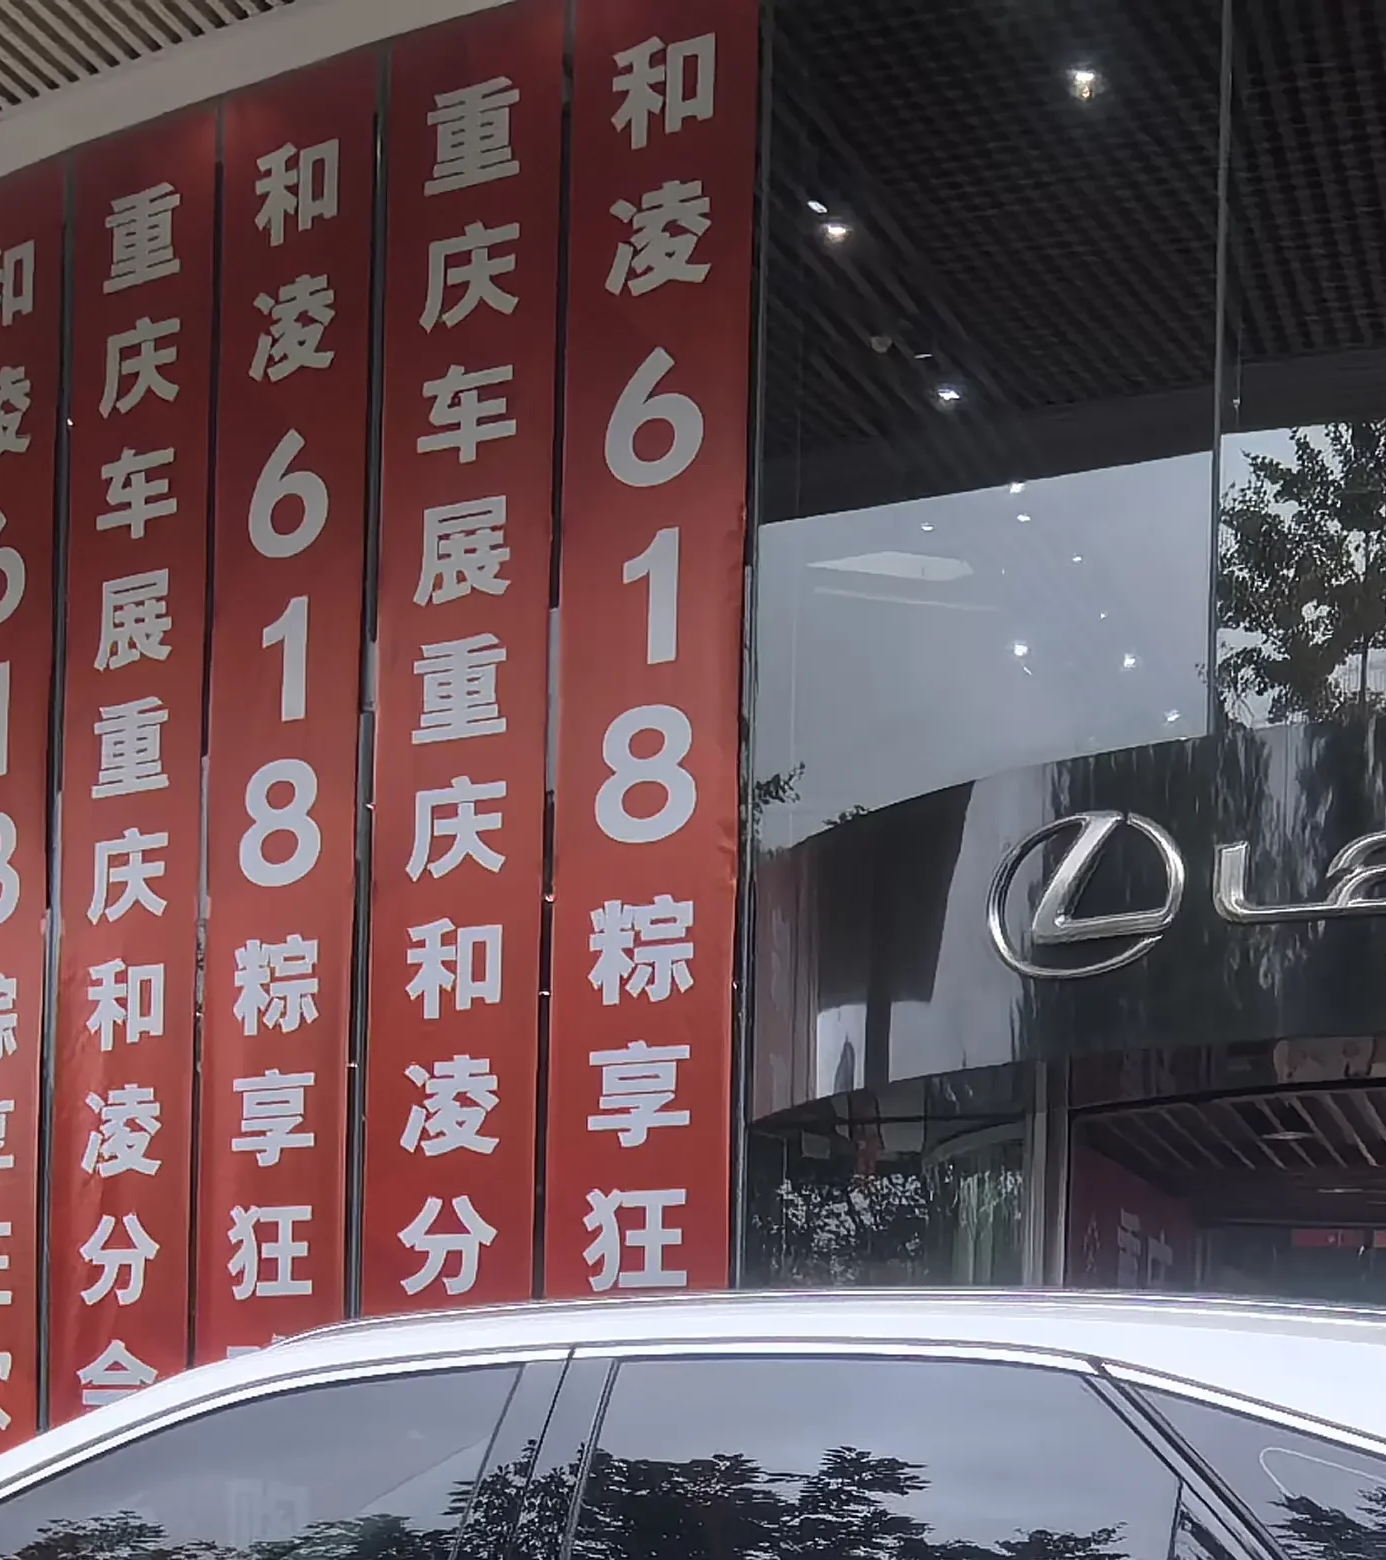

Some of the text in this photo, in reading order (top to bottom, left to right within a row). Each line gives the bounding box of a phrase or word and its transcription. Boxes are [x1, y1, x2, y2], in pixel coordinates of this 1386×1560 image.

[226, 139, 340, 1356] 和凌618粽享狂
[398, 75, 522, 1296] 重庆车展重庆和凌分
[582, 32, 716, 1292] 和凌618粽享狂
